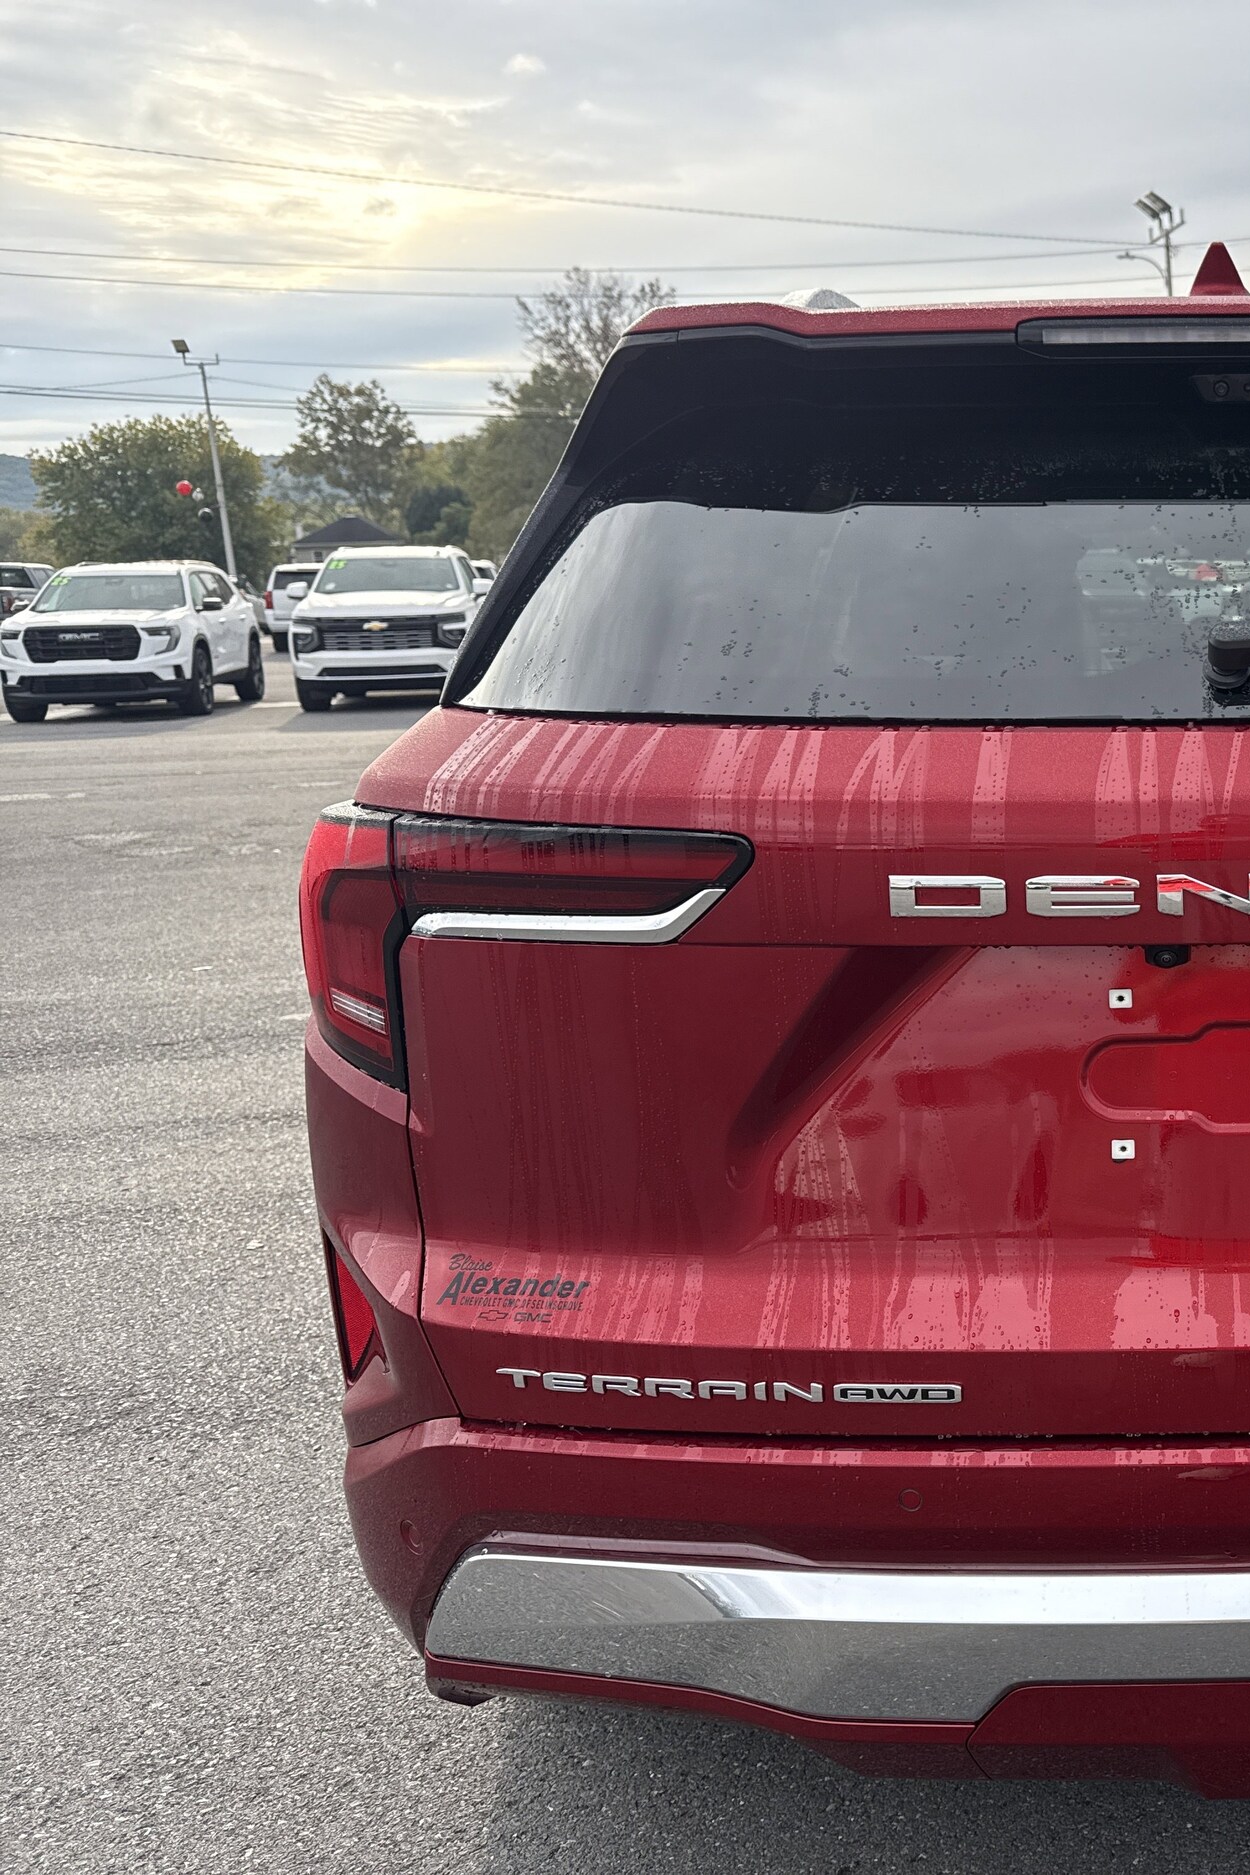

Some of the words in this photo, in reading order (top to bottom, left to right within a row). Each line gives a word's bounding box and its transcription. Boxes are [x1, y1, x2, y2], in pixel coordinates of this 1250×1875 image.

[58, 632, 100, 641] GMC
[449, 1253, 493, 1271] Blaise
[436, 1272, 589, 1305] Alexander
[513, 1311, 553, 1323] GMC
[495, 1368, 823, 1403] TERRAIN
[837, 1386, 959, 1401] AWD
